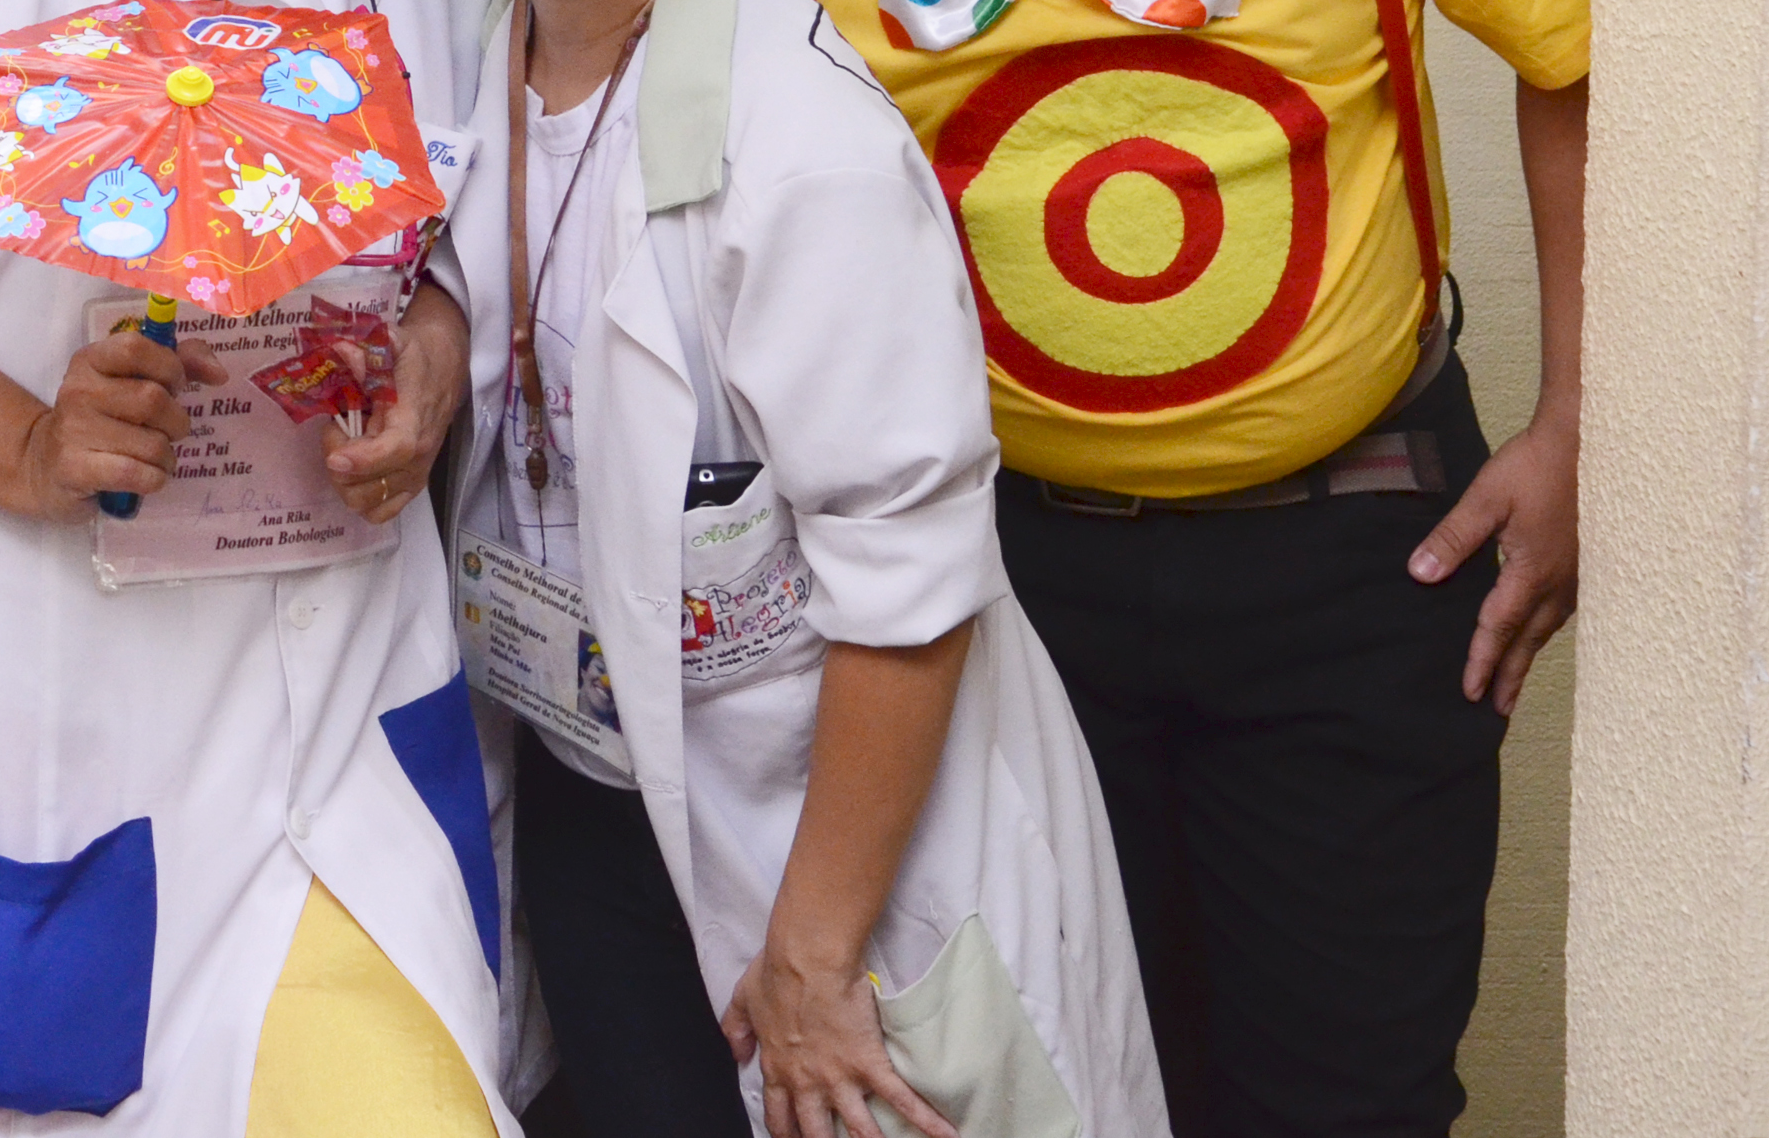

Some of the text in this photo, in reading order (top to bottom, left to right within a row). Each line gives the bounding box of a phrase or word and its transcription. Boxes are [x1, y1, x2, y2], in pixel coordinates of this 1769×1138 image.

[174, 313, 238, 333] nselho
[242, 309, 314, 329] Melhora
[209, 337, 259, 353] onselho
[210, 397, 253, 417] Rika
[205, 442, 230, 457] Pai
[220, 462, 253, 477] Mãe
[257, 511, 311, 527] Ana Rika
[215, 525, 346, 551] Doutora Bobologista
[476, 544, 582, 605] Conselho Melhoral de
[705, 550, 797, 615] Projeto
[491, 567, 529, 593] Conselho
[531, 587, 568, 613] Regional
[700, 576, 807, 648] Alegria
[489, 608, 547, 643] Abelhajura
